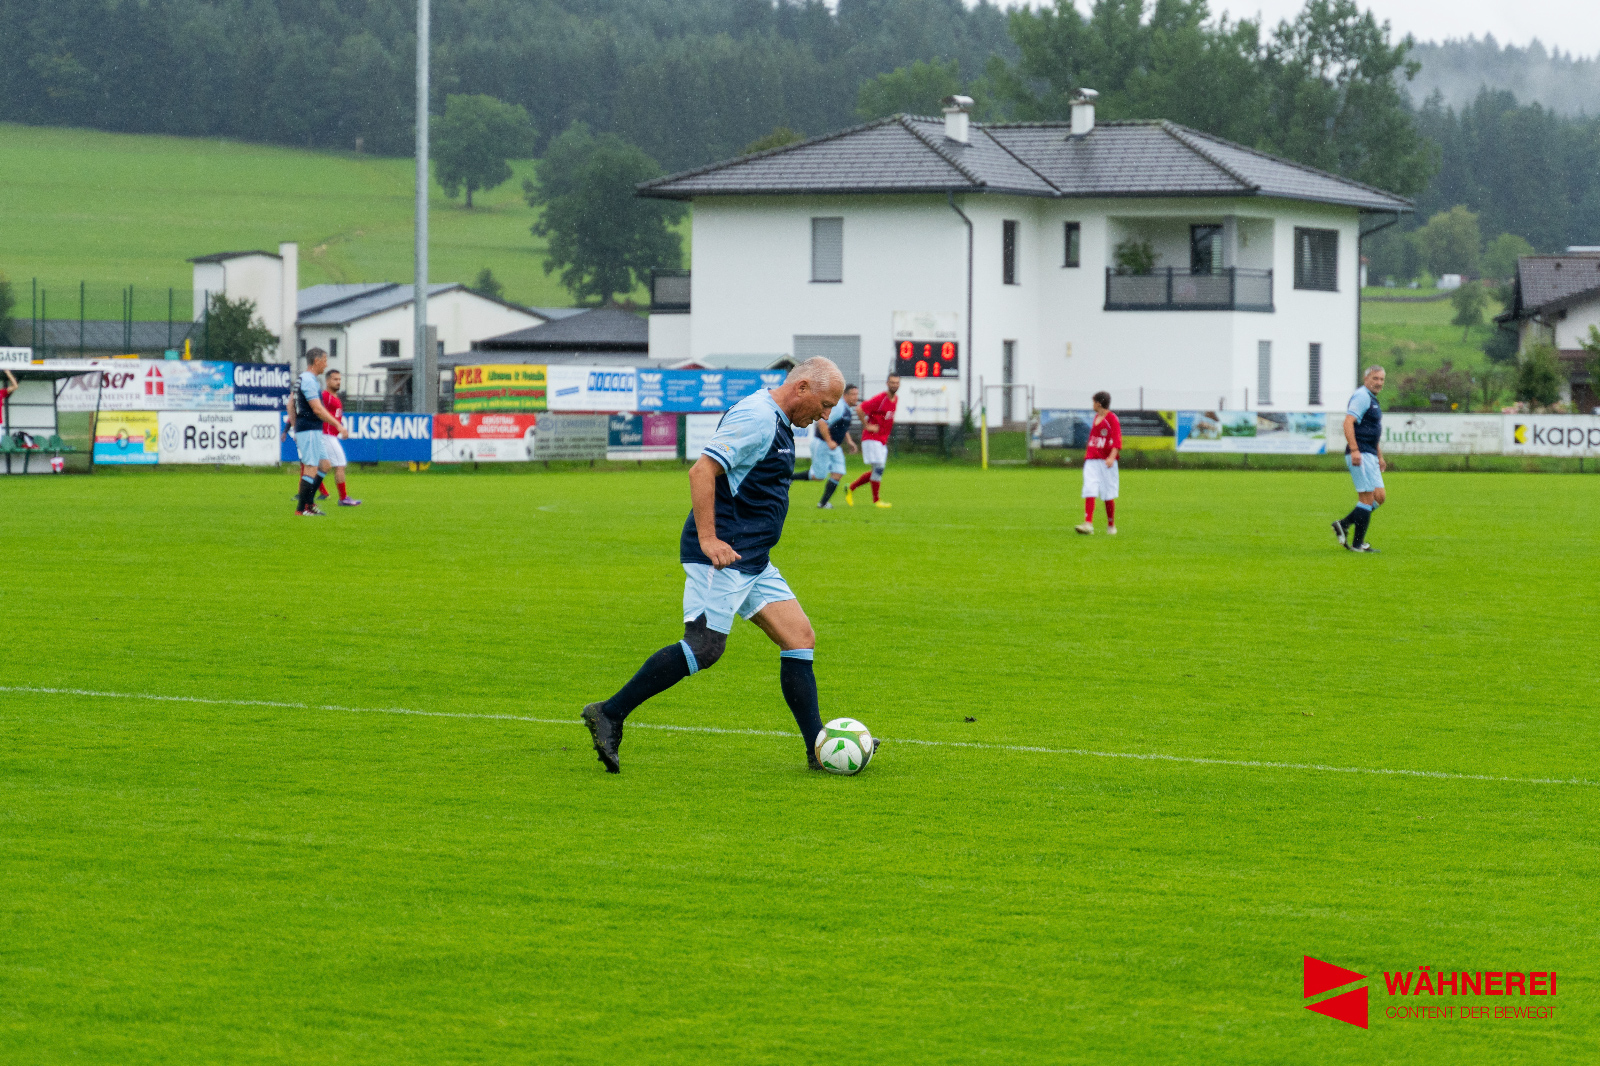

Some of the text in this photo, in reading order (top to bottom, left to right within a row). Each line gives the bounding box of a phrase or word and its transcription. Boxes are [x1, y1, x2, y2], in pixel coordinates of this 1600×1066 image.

[900, 341, 914, 360] 0
[942, 342, 955, 360] 0
[234, 365, 291, 388] Getränke
[197, 414, 233, 423] Autohaus
[183, 425, 248, 449] Reiser
